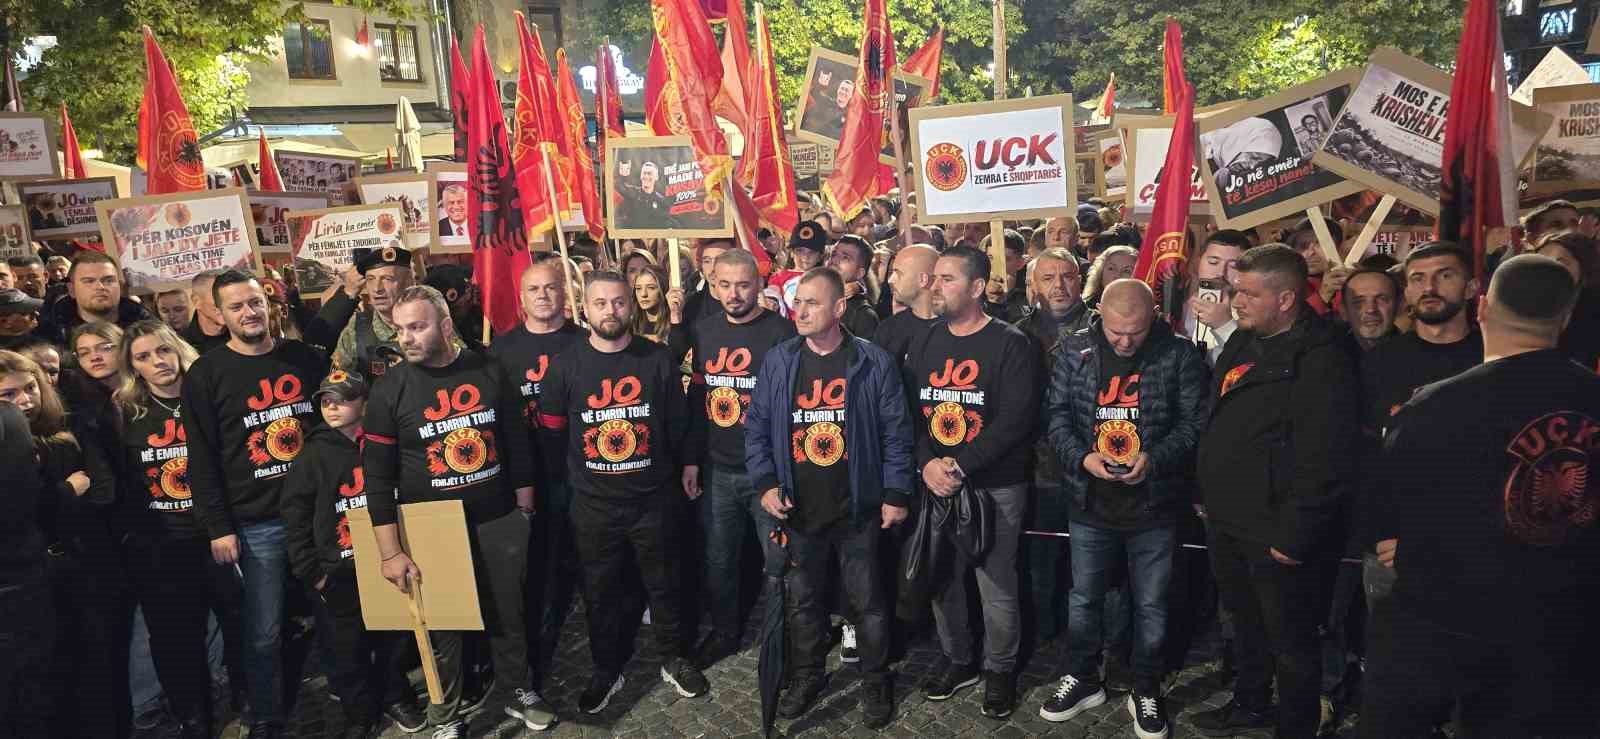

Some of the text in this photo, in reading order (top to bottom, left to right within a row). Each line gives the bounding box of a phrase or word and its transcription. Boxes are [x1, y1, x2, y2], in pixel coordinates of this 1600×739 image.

[1393, 81, 1428, 106] MOS
[1427, 96, 1441, 112] E
[975, 131, 1057, 172] UÇK
[974, 166, 1062, 185] ZEMRA E SHQIPTARISË
[1225, 174, 1244, 193] Jo
[1247, 167, 1264, 183] në
[1267, 156, 1301, 175] emër
[131, 229, 162, 247] PËR
[314, 220, 344, 239] Liria
[202, 247, 225, 259] TIME
[705, 346, 752, 374] JO
[929, 358, 980, 387] JO
[248, 373, 303, 411] JO
[520, 382, 534, 396] NË
[587, 375, 642, 408] JO
[798, 378, 846, 409] JO
[920, 387, 985, 405] NË EMRIN TONË
[423, 384, 481, 421] JO
[581, 403, 651, 424] NË EMRIN TONË
[244, 411, 260, 429] NË
[259, 404, 293, 424] EMRIN
[418, 409, 496, 440] NË EMRIN TONË
[791, 408, 803, 423] NË
[804, 410, 835, 423] EMRIN
[141, 447, 155, 463] NË
[459, 475, 465, 484] E
[335, 498, 349, 513] NË
